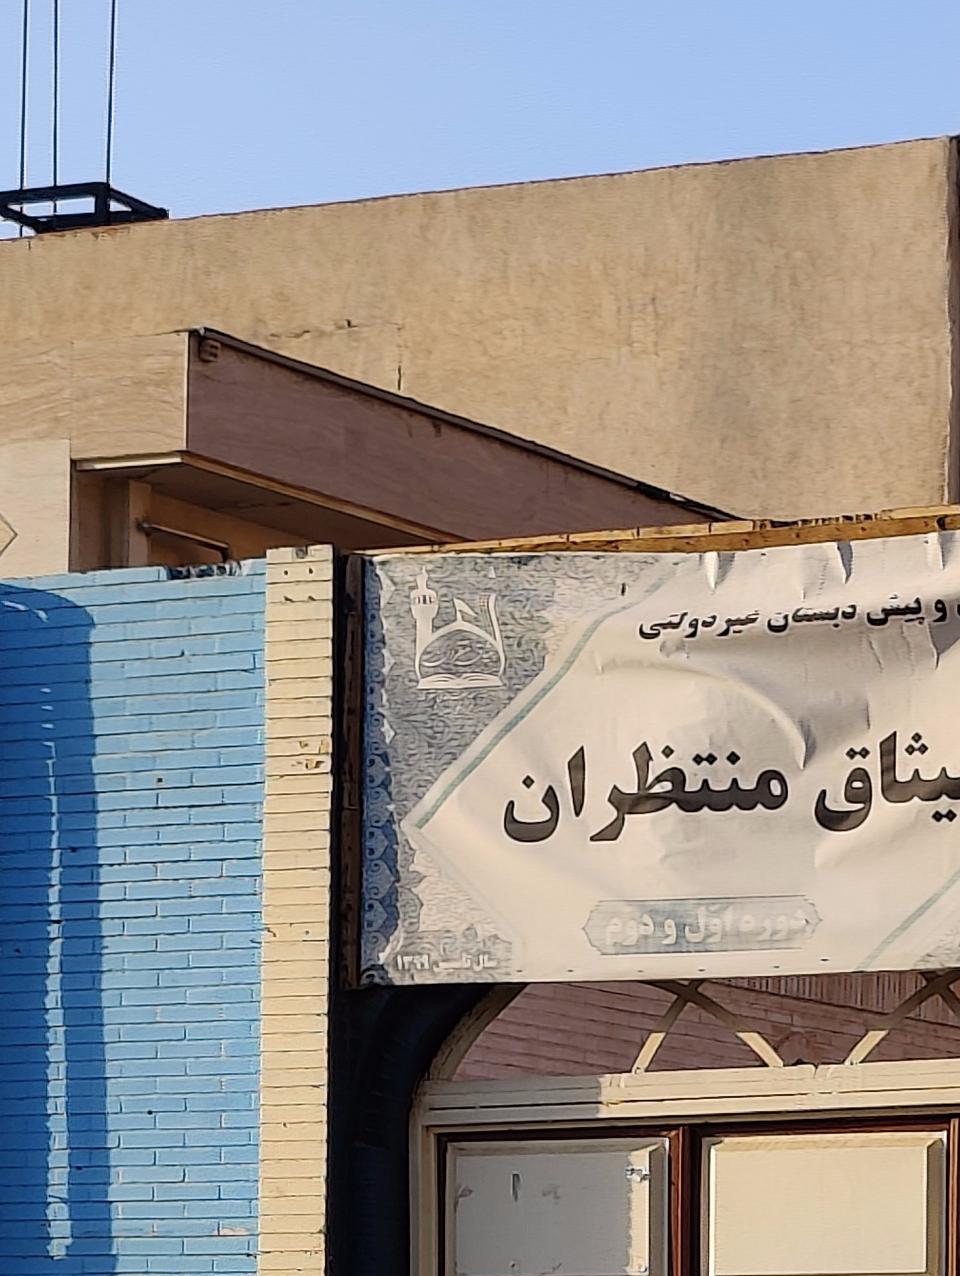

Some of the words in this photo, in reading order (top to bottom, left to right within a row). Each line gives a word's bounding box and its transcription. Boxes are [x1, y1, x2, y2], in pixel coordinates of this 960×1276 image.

[866, 594, 924, 625] پیش
[933, 597, 947, 622] و
[503, 740, 789, 843] منتظران
[661, 918, 678, 945] و
